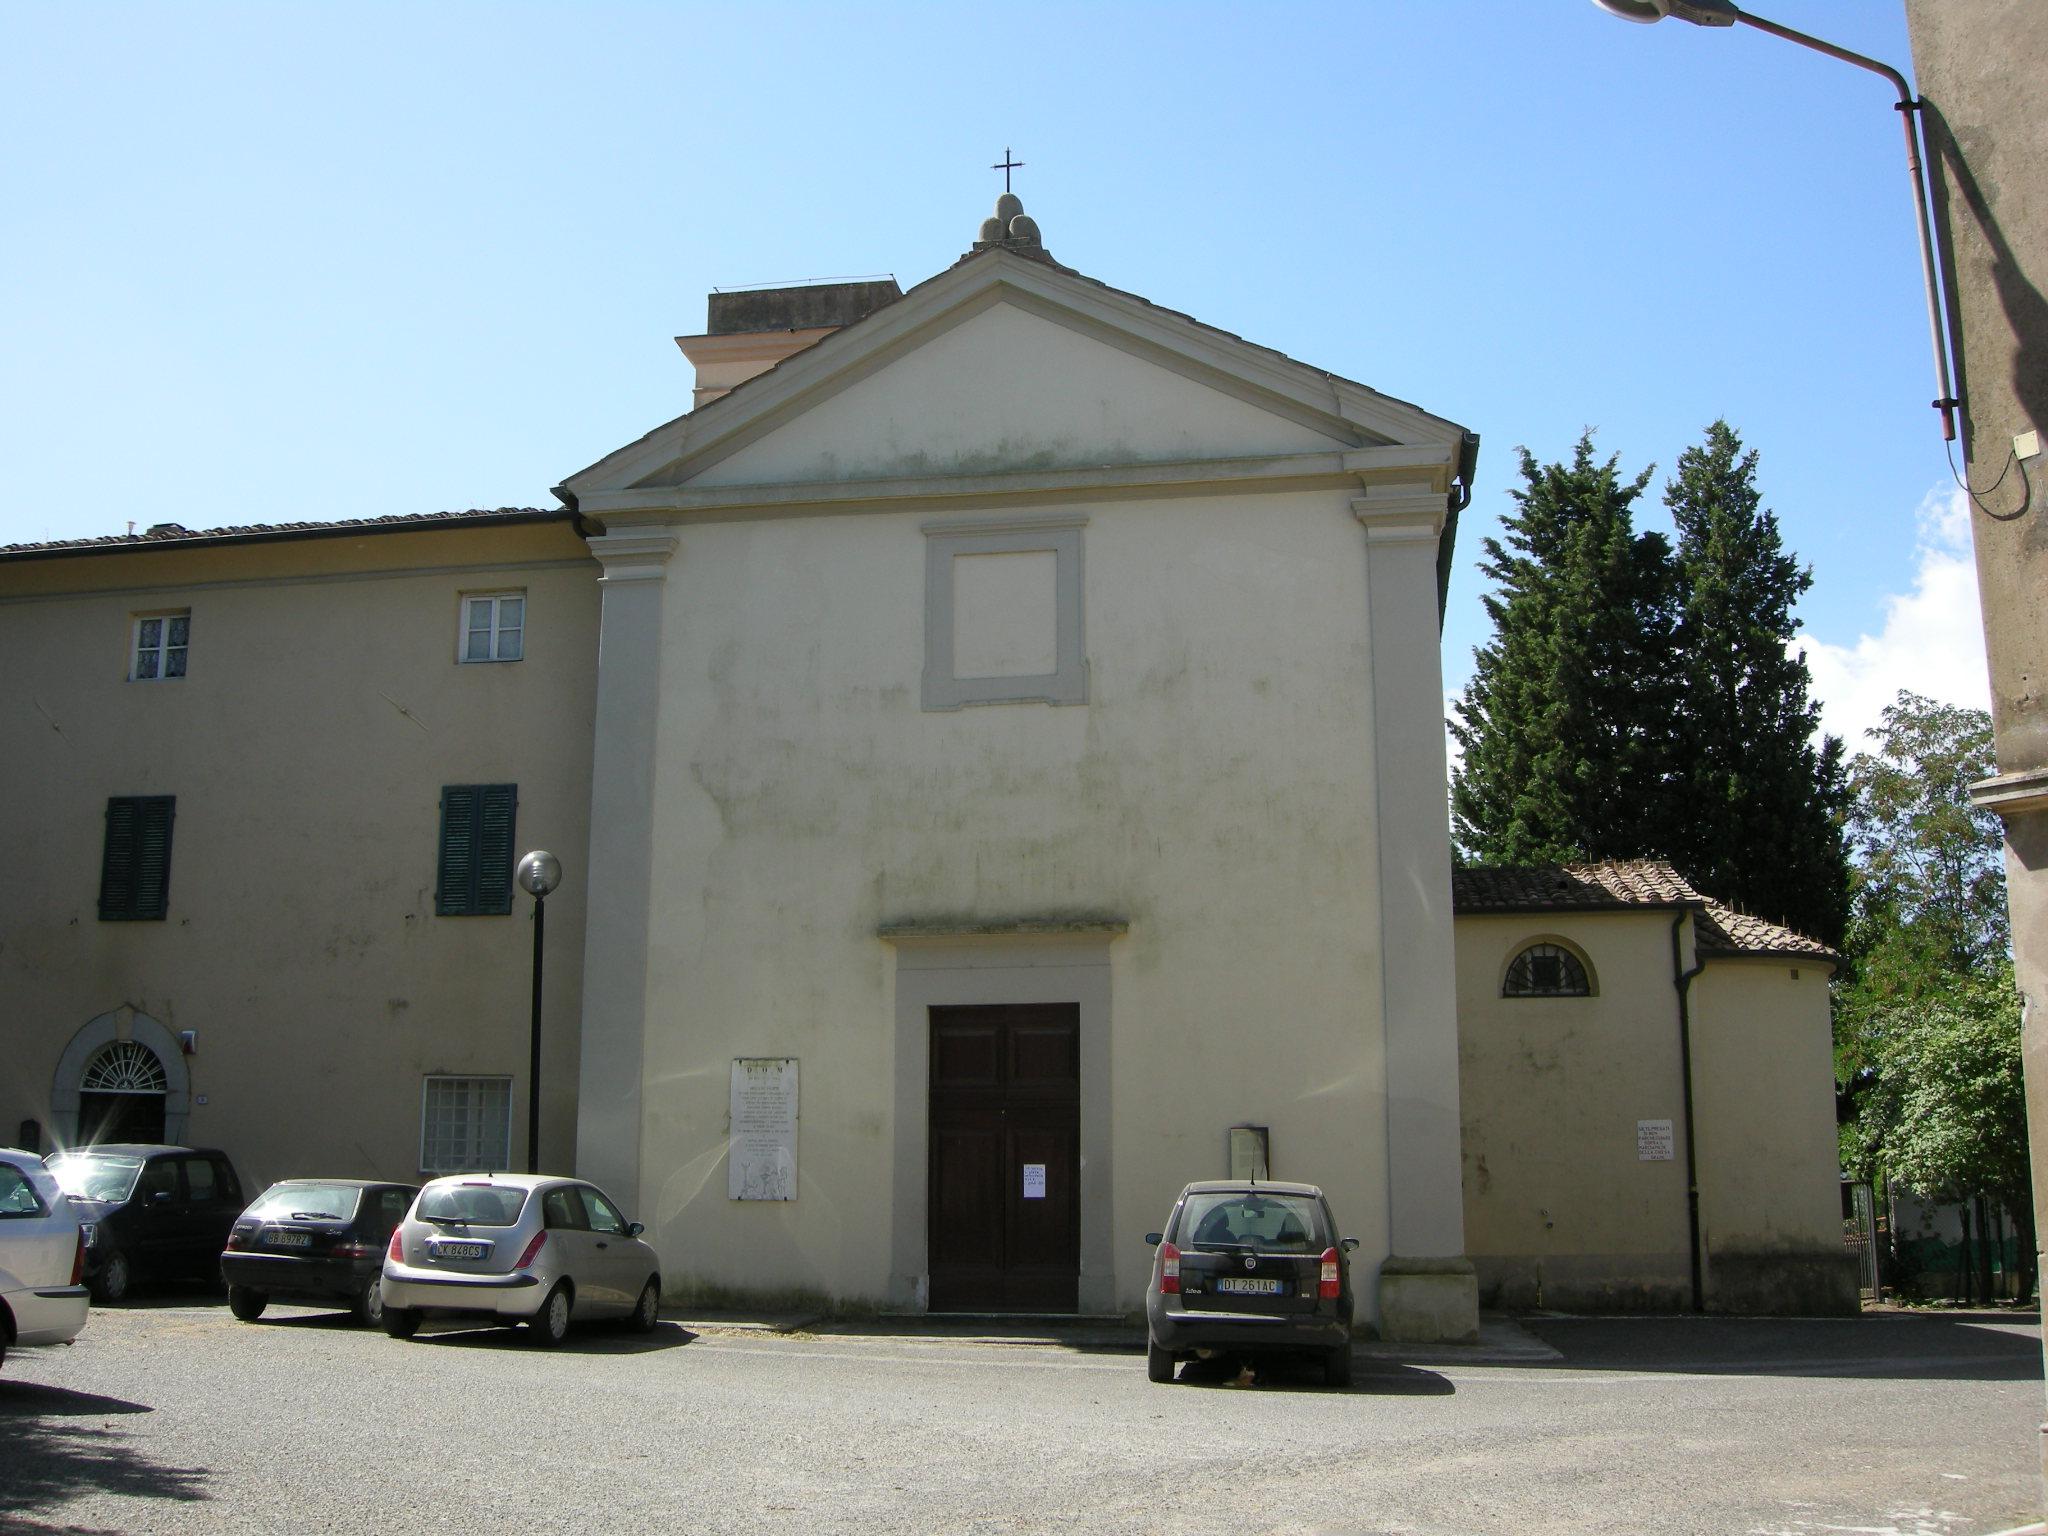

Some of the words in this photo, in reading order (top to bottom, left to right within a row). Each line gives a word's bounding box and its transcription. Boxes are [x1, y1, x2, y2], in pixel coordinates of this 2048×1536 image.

[437, 1244, 449, 1255] CK
[451, 1245, 481, 1256] 848CS
[1224, 1279, 1237, 1290] DT
[1242, 1279, 1276, 1291] 261AC
